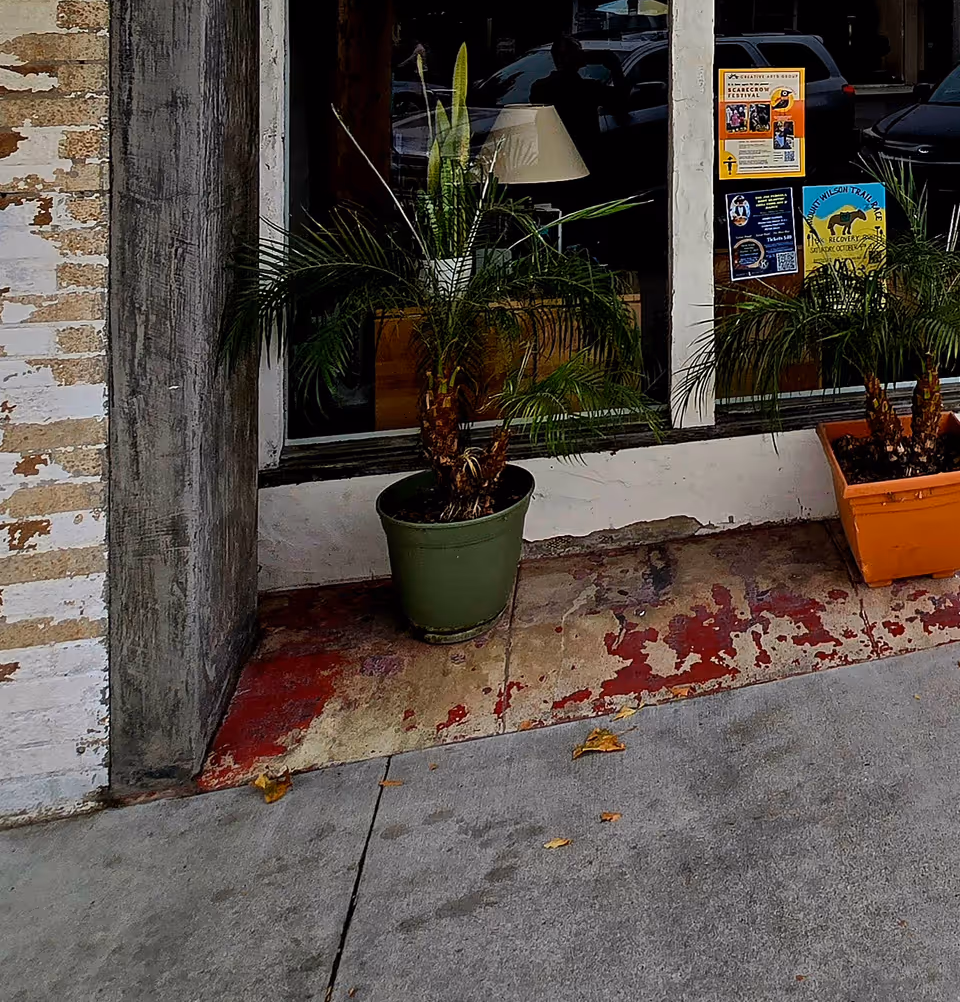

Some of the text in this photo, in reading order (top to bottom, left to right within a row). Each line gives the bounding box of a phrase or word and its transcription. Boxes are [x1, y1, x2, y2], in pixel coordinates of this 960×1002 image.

[820, 185, 849, 202] WILSON
[850, 185, 873, 203] TRAIL
[870, 200, 883, 222] RACE
[828, 235, 860, 243] RECOVERY
